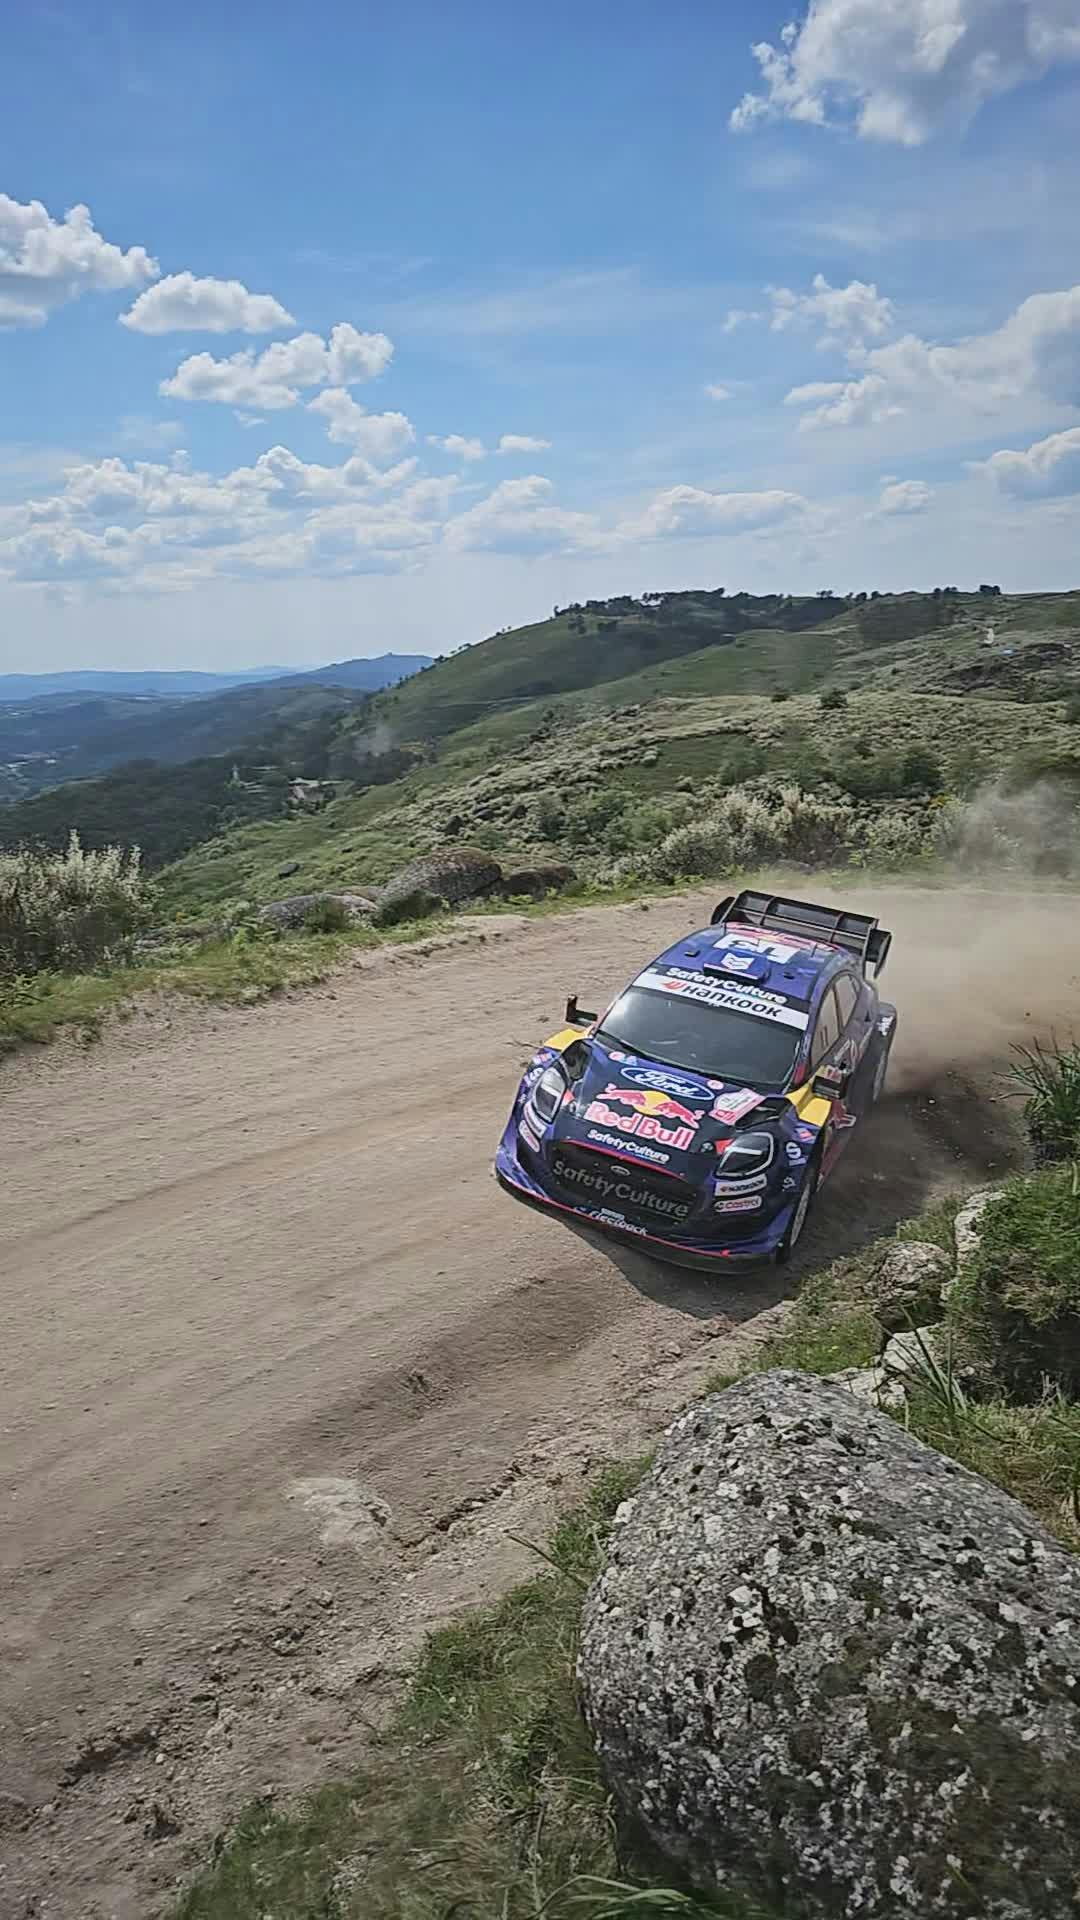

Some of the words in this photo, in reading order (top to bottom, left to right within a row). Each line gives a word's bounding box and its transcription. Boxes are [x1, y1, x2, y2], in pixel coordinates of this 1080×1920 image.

[666, 966, 788, 1005] SafetyCulture
[634, 1070, 699, 1096] Ford
[586, 1128, 671, 1164] SafetyCulture
[552, 1160, 689, 1217] SafetyCulture
